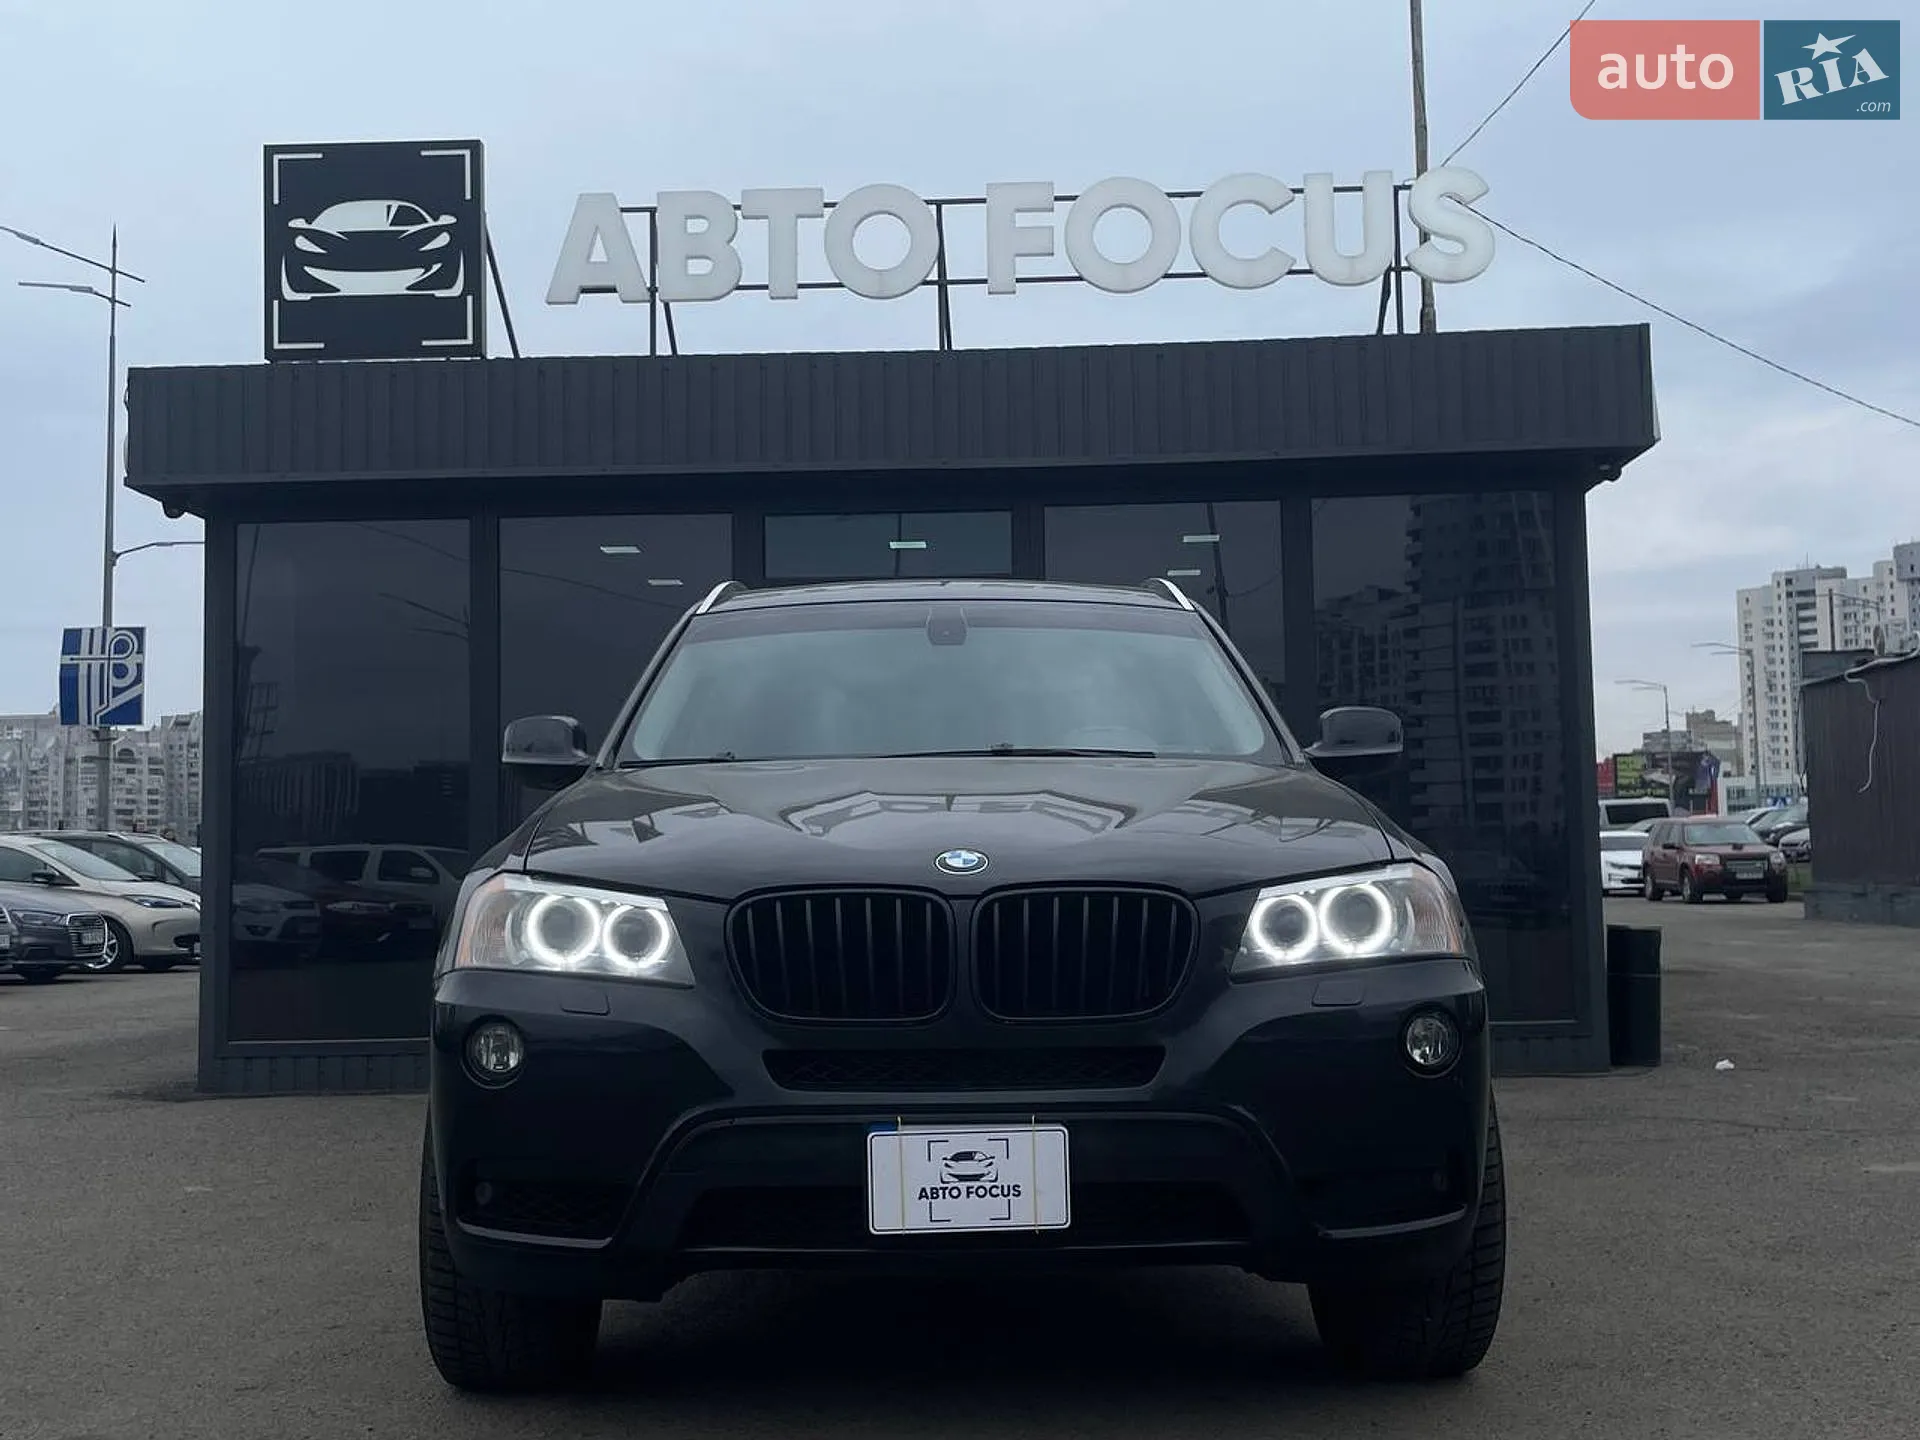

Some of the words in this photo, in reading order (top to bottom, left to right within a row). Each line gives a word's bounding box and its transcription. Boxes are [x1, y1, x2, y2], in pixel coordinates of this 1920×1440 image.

[546, 183, 941, 305] АВТО
[986, 165, 1496, 296] FOCUS
[918, 1186, 962, 1201] АВТО
[966, 1184, 1022, 1199] FOCUS
